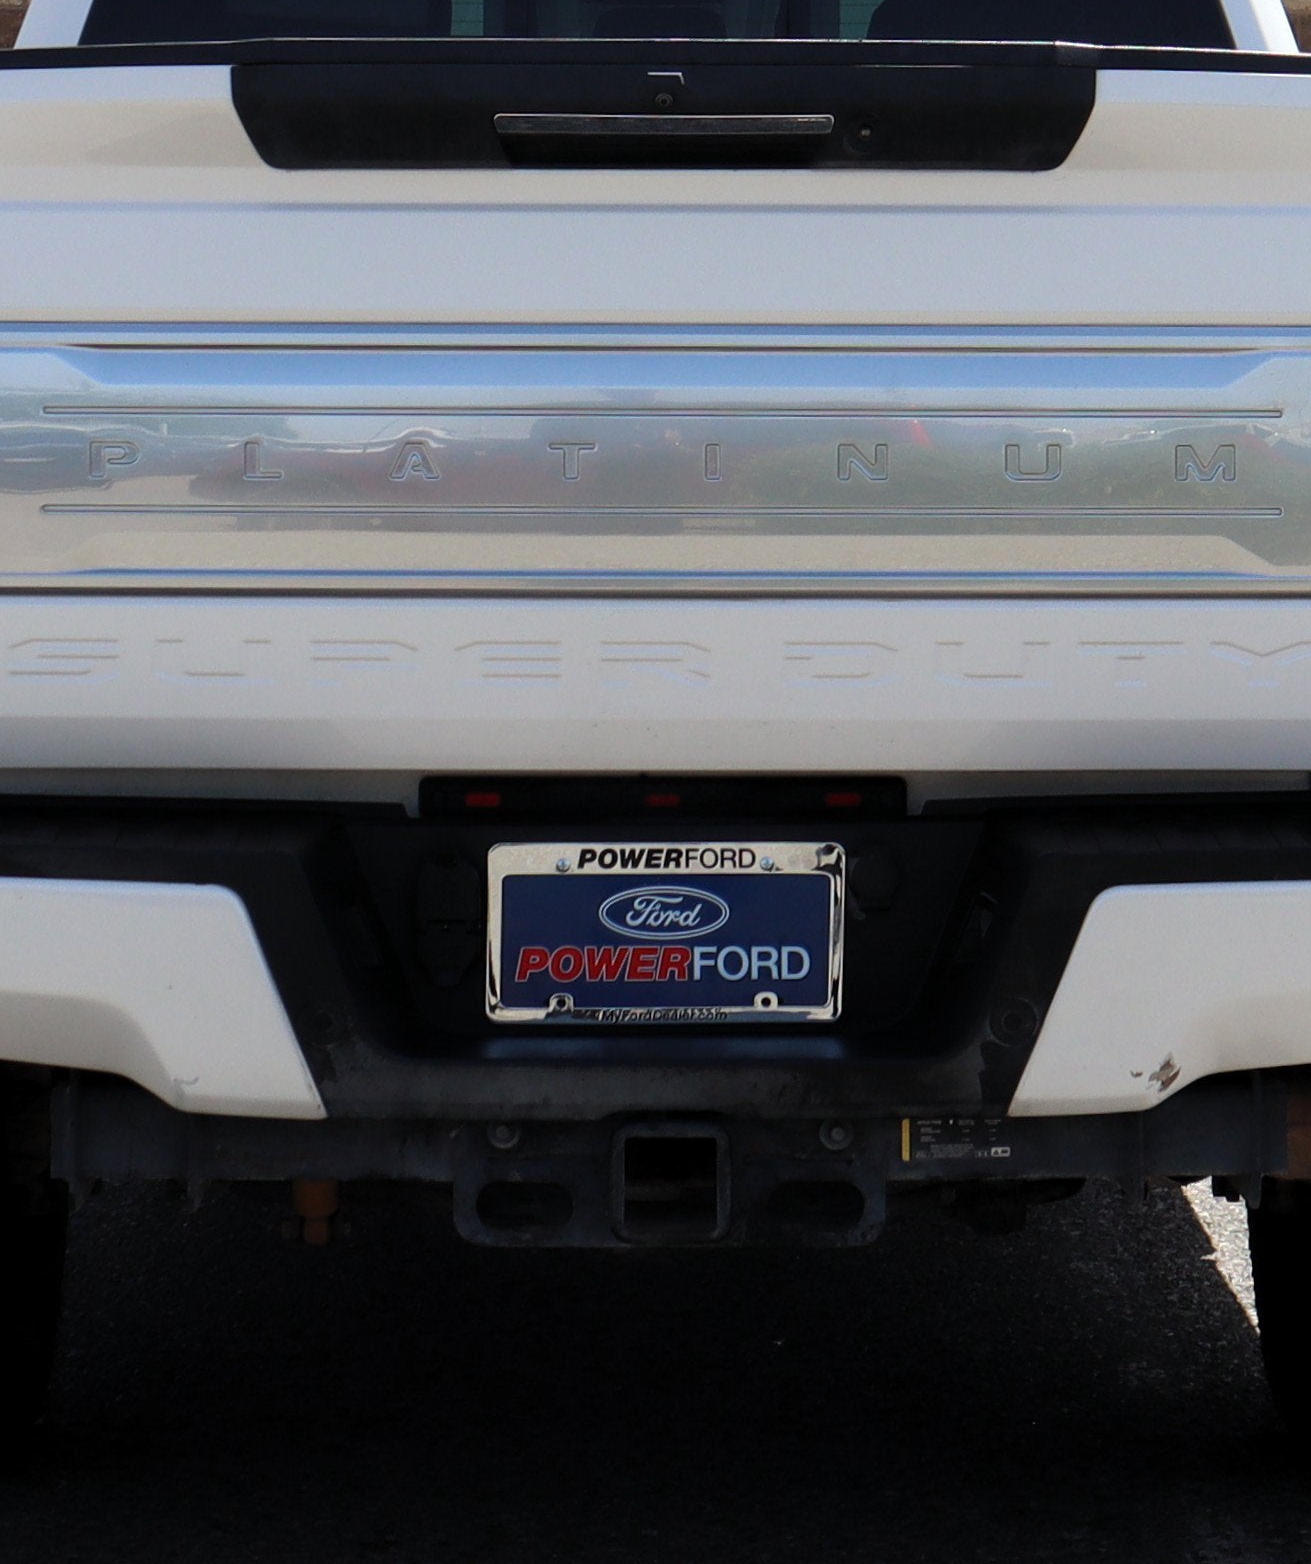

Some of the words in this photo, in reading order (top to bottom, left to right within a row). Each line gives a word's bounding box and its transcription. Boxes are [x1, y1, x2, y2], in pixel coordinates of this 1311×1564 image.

[88, 439, 1238, 482] PLATINUM
[8, 637, 712, 687] SUPER
[577, 847, 757, 870] POWERFORD
[625, 897, 704, 929] Ford
[514, 945, 812, 983] POWERFORD
